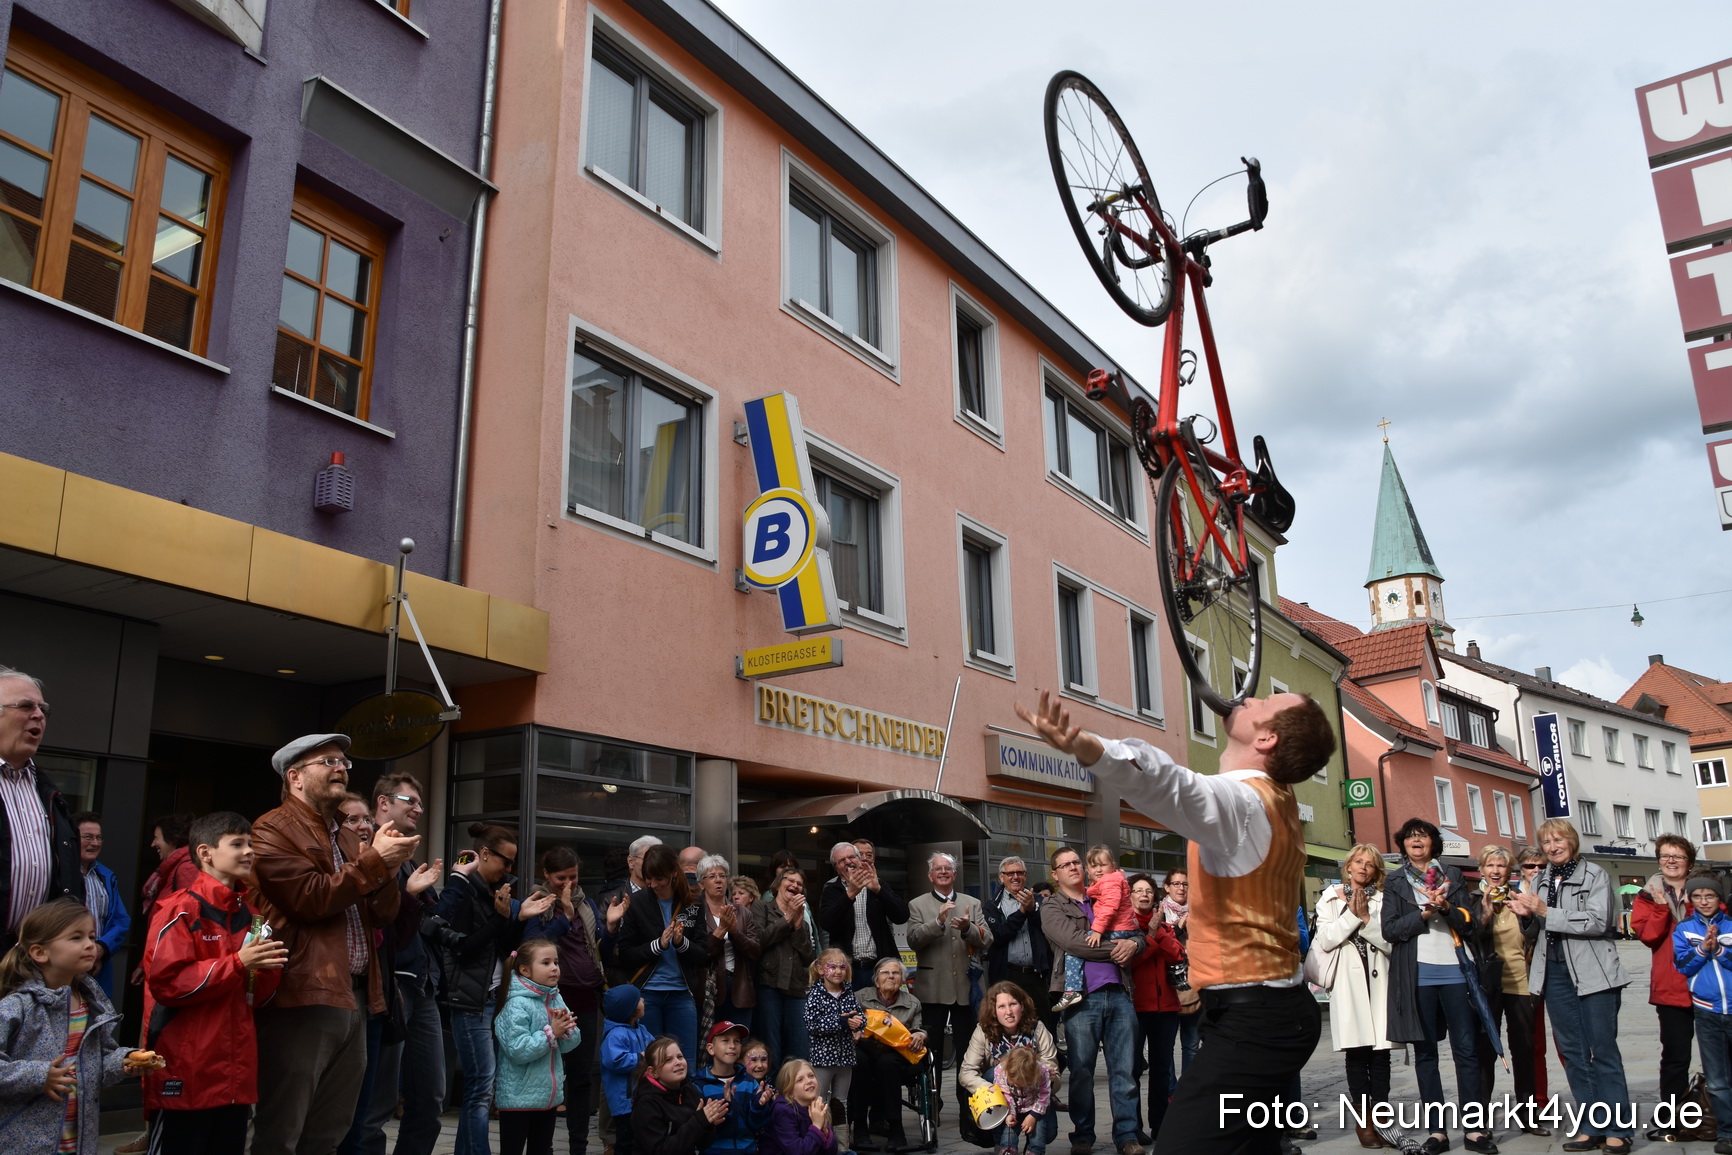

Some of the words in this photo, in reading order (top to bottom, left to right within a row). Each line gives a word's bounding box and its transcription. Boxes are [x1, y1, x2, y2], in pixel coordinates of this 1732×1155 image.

[752, 511, 791, 564] B
[748, 646, 817, 668] KLOSTERGASSE
[820, 645, 826, 656] 4
[759, 686, 949, 759] BRETSCHNEIDER
[1001, 745, 1094, 784] KOMMUNIKATION
[1550, 722, 1562, 771] TAILOR
[1556, 772, 1567, 808] TOM
